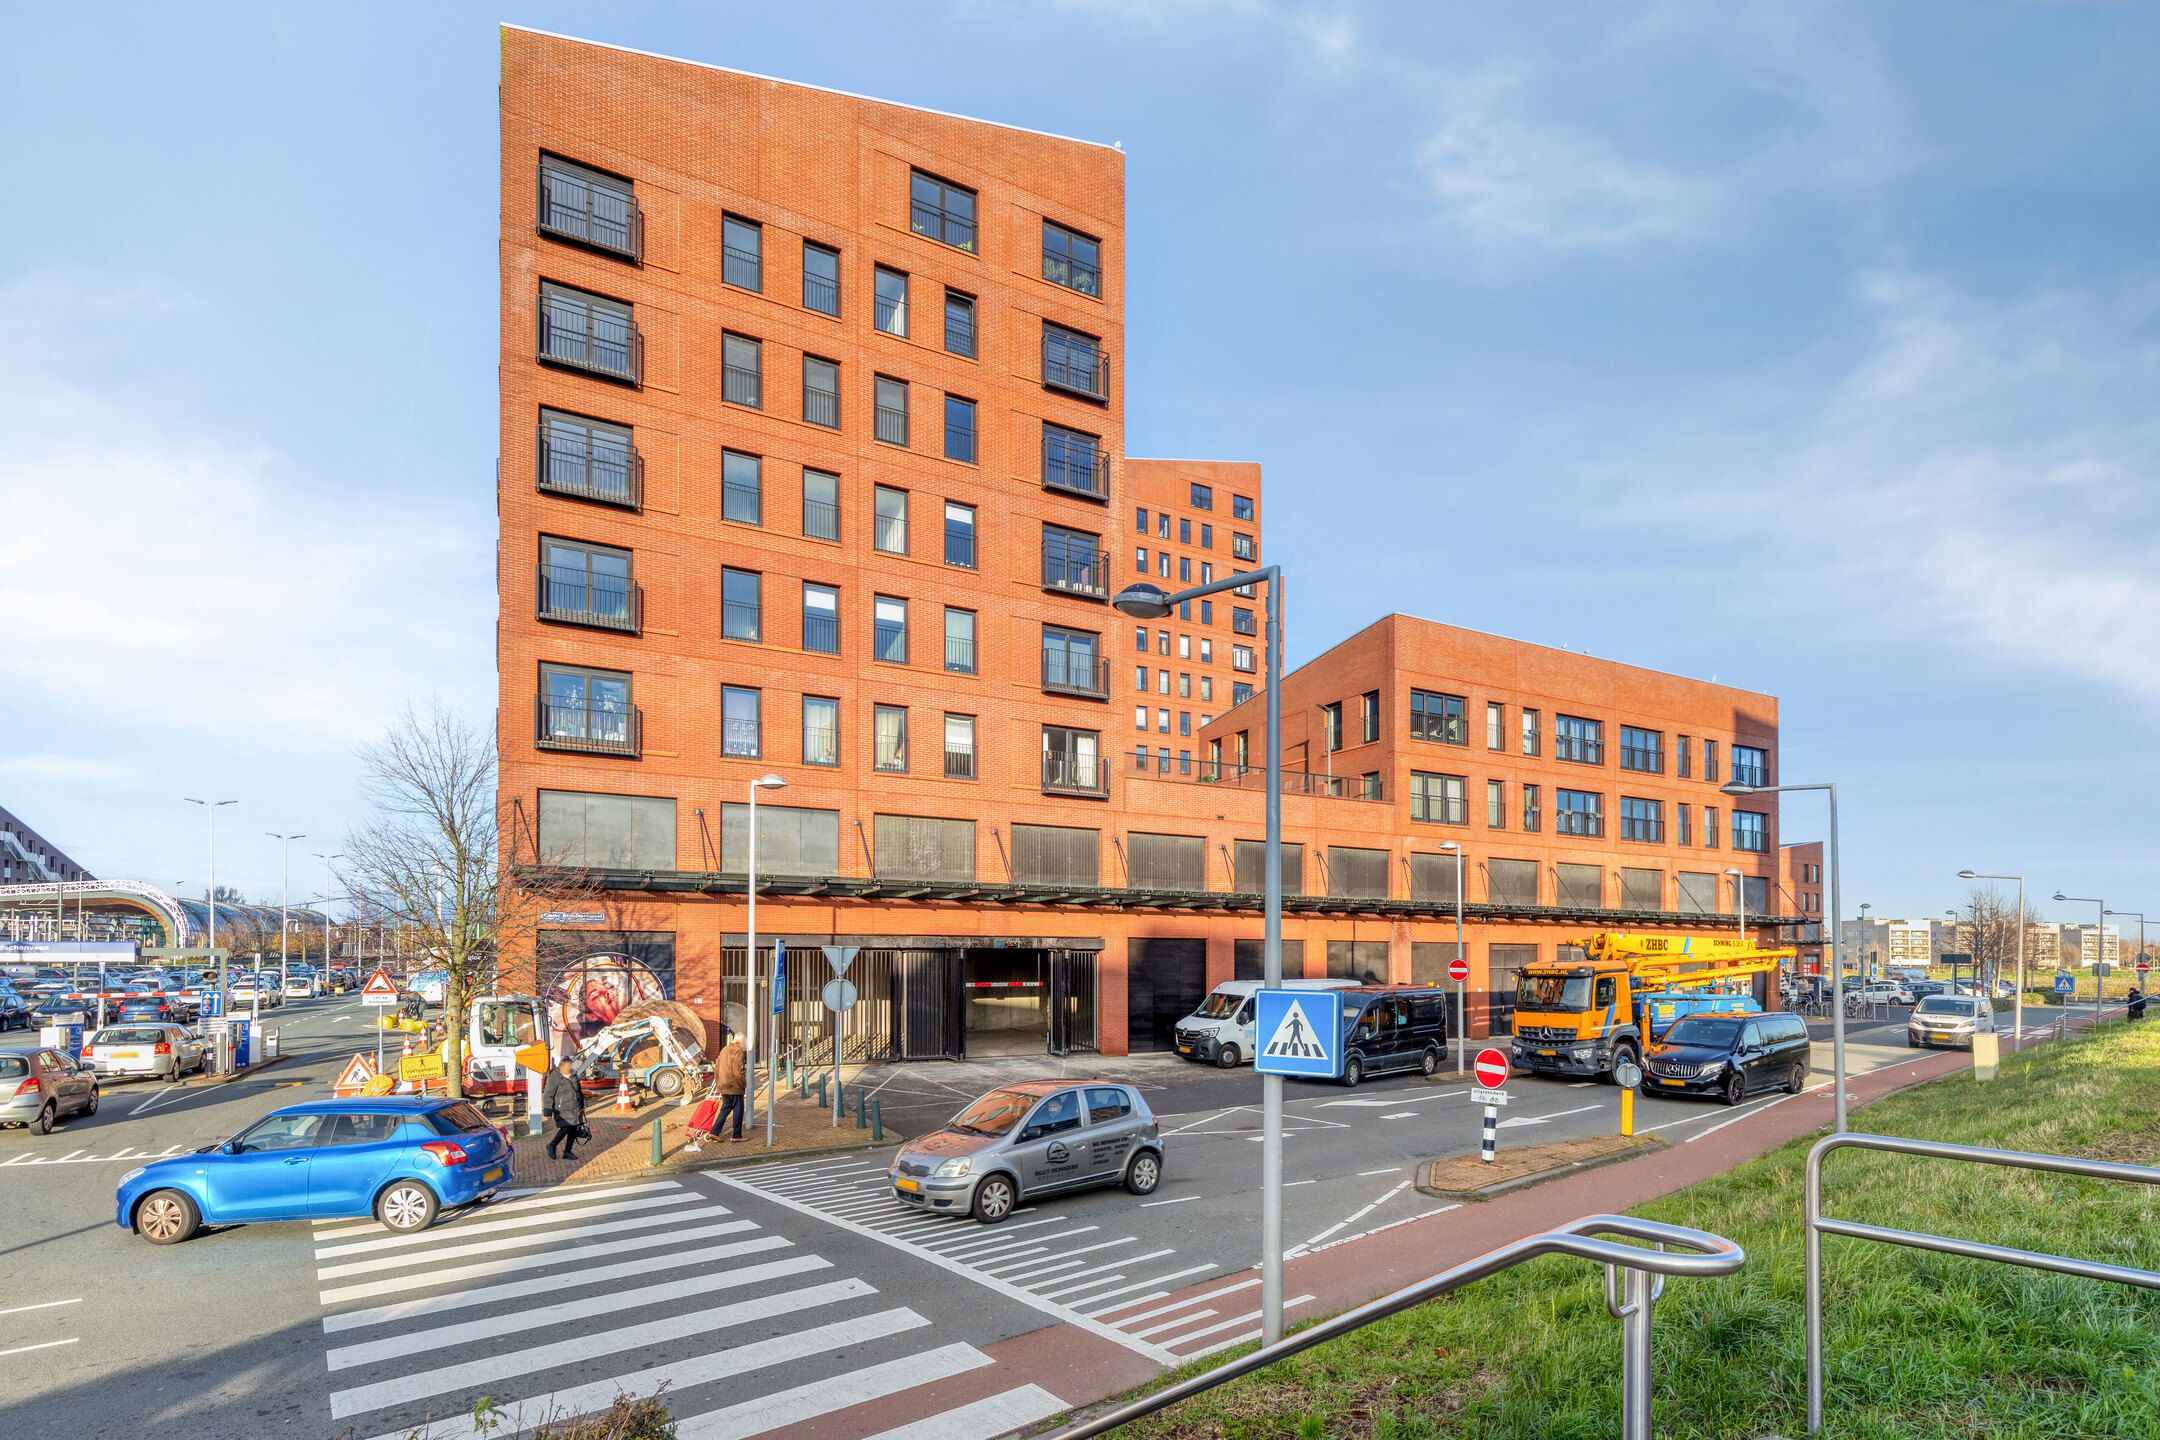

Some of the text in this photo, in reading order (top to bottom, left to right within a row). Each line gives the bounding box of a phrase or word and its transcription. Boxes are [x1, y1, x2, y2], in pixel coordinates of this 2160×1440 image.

[1646, 939, 1669, 951] ZHBC
[1713, 939, 1732, 947] SCHWING
[1051, 1164, 1079, 1173] REINIGERS
